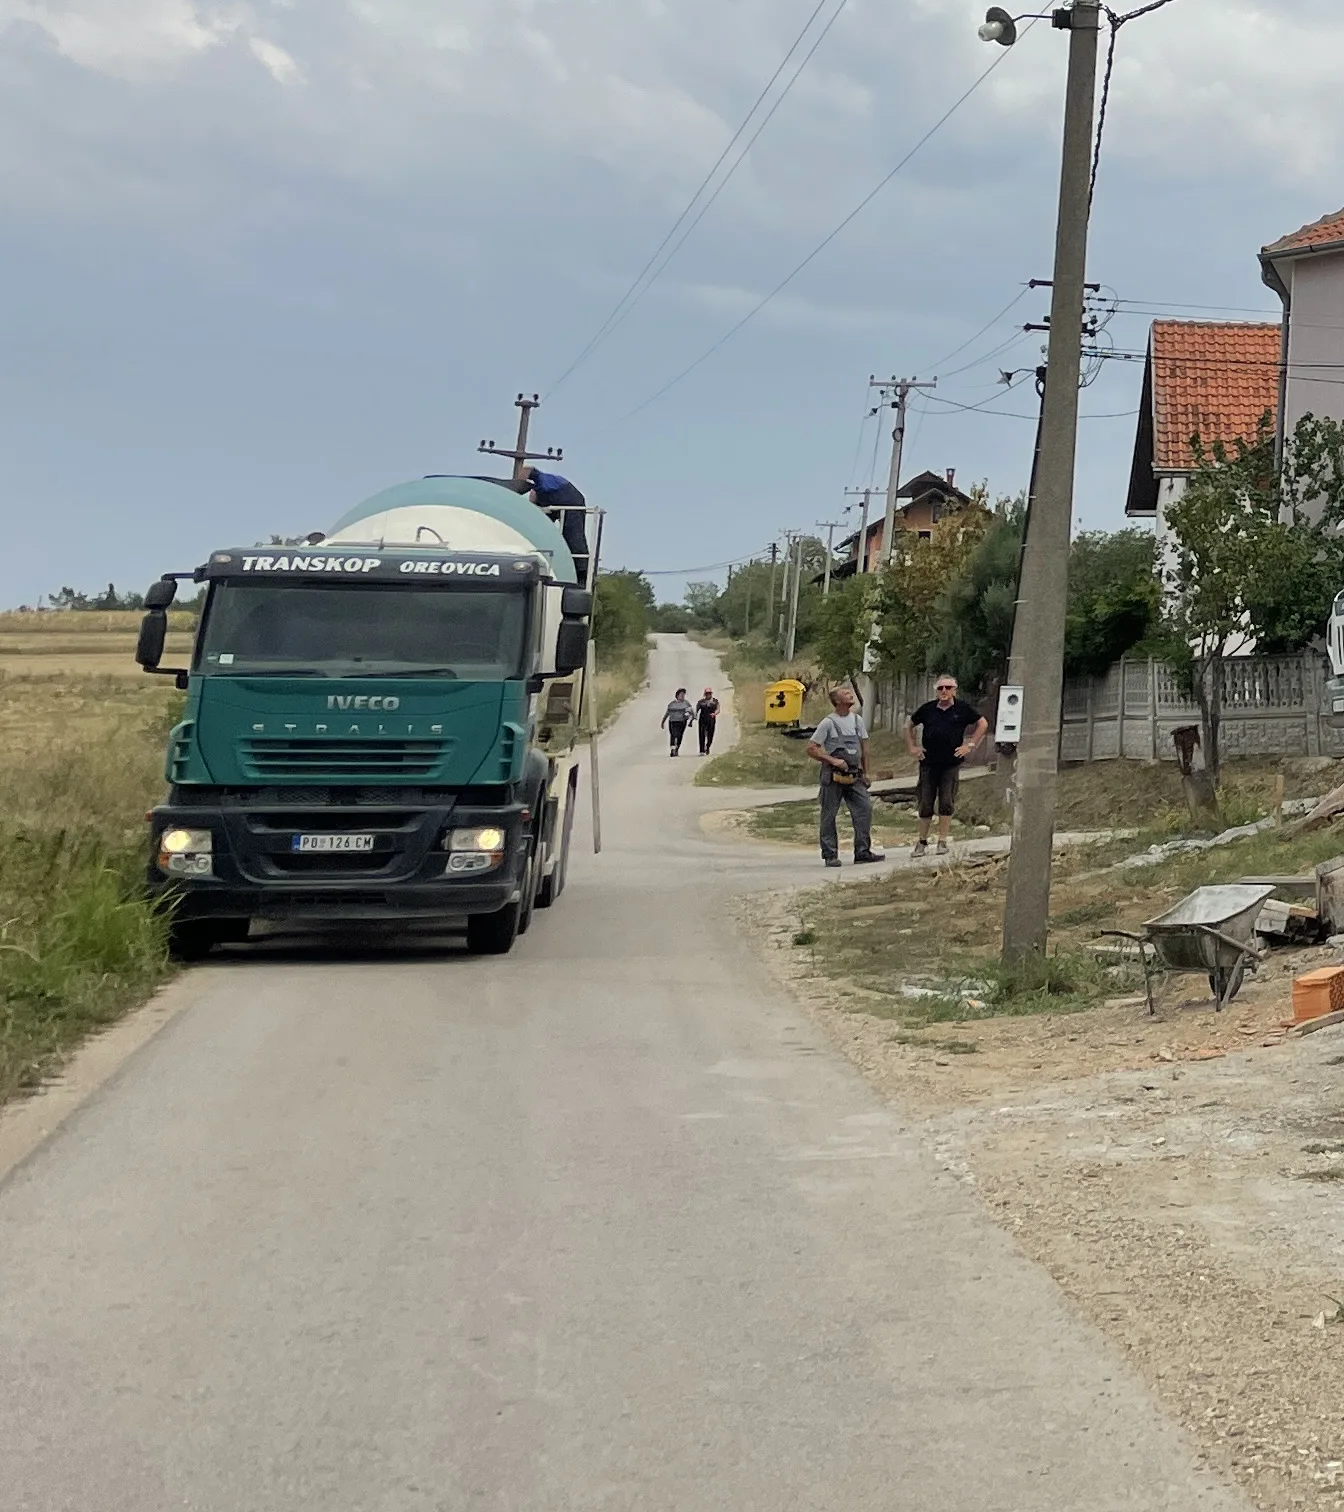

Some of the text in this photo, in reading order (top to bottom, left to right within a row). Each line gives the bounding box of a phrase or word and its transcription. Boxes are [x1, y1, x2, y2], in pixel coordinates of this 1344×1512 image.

[242, 556, 500, 576] TRANSKOP OREOVICA
[327, 694, 400, 711] IVECO
[252, 723, 443, 735] STRALIS
[302, 836, 318, 849] PO
[329, 836, 350, 849] 126
